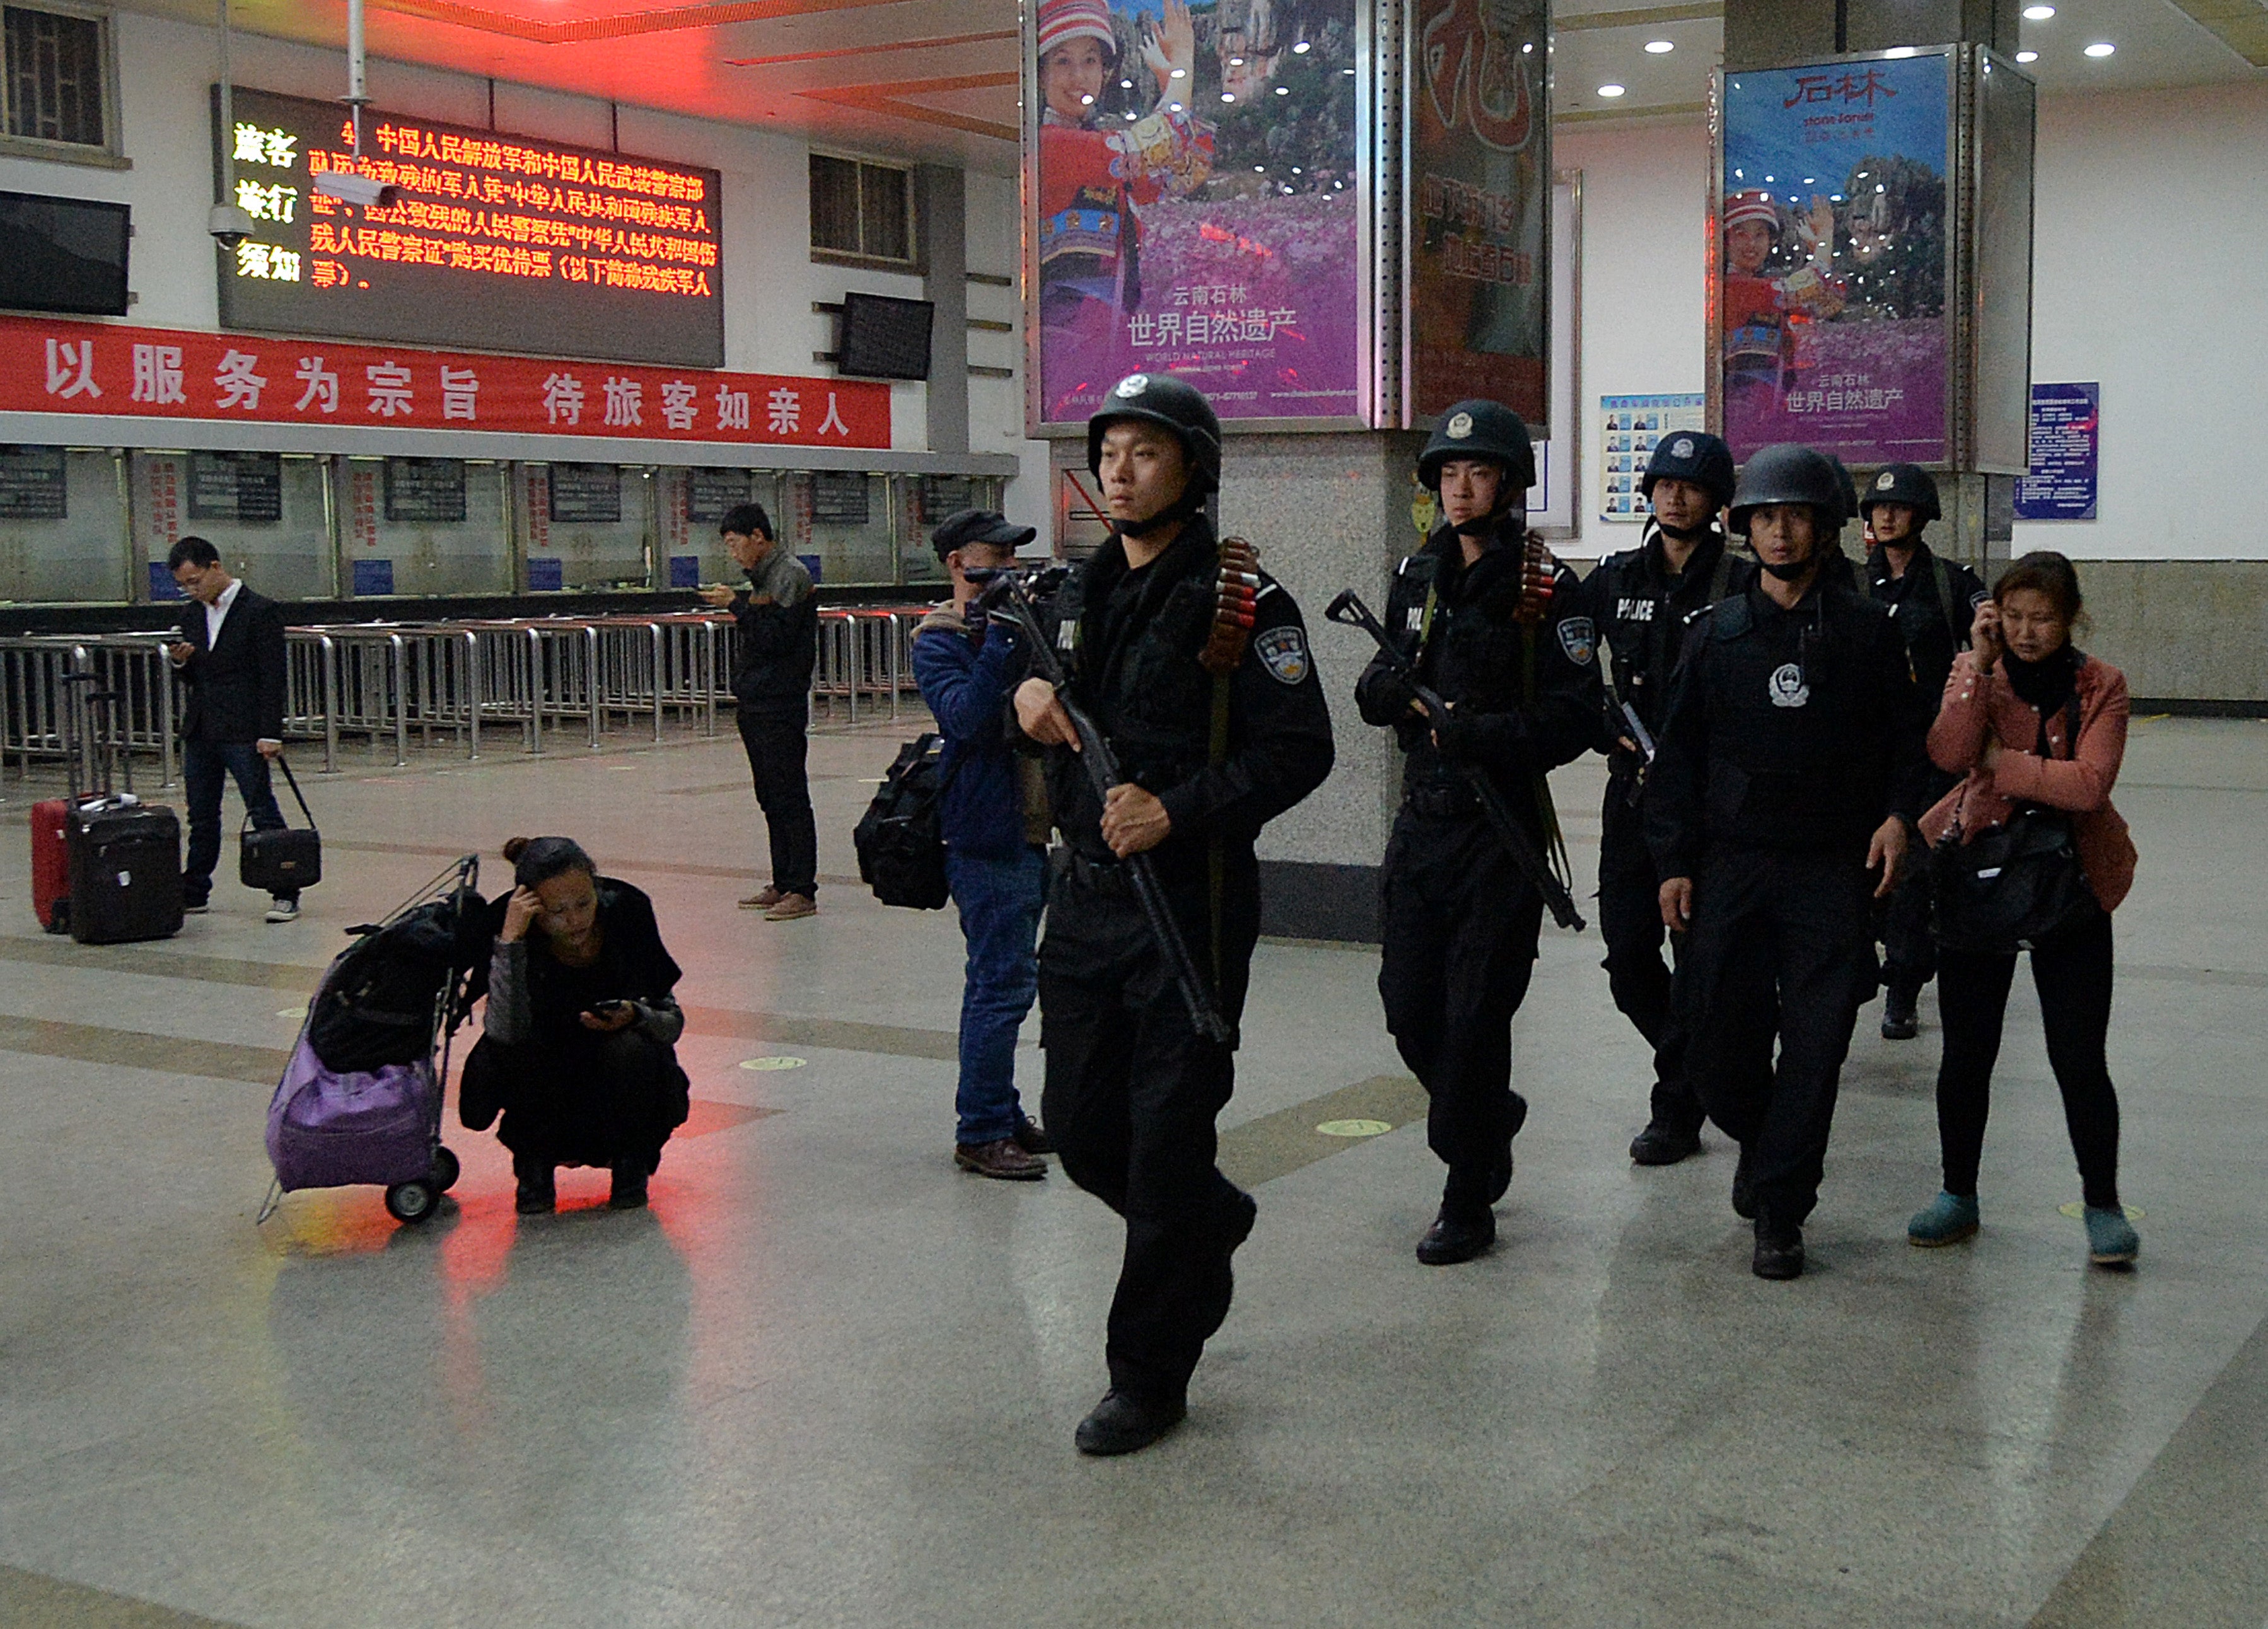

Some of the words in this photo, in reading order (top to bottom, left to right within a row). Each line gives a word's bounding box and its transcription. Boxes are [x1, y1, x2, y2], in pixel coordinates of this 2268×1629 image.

[1784, 68, 1897, 108] 石林
[233, 122, 298, 168] 旅客
[234, 179, 298, 224] 旅行
[236, 238, 301, 282] 须知
[1173, 284, 1247, 306] 云南石林
[1127, 306, 1297, 347] 世界自然遗产
[1145, 352, 1180, 362] WORLD
[1183, 351, 1226, 361] NATURAL
[46, 338, 480, 421] 以服务为宗旨
[542, 373, 849, 437] 待旅客如亲人
[1786, 387, 1904, 413] 世界自然遗产
[1818, 373, 1870, 388] 云南石林
